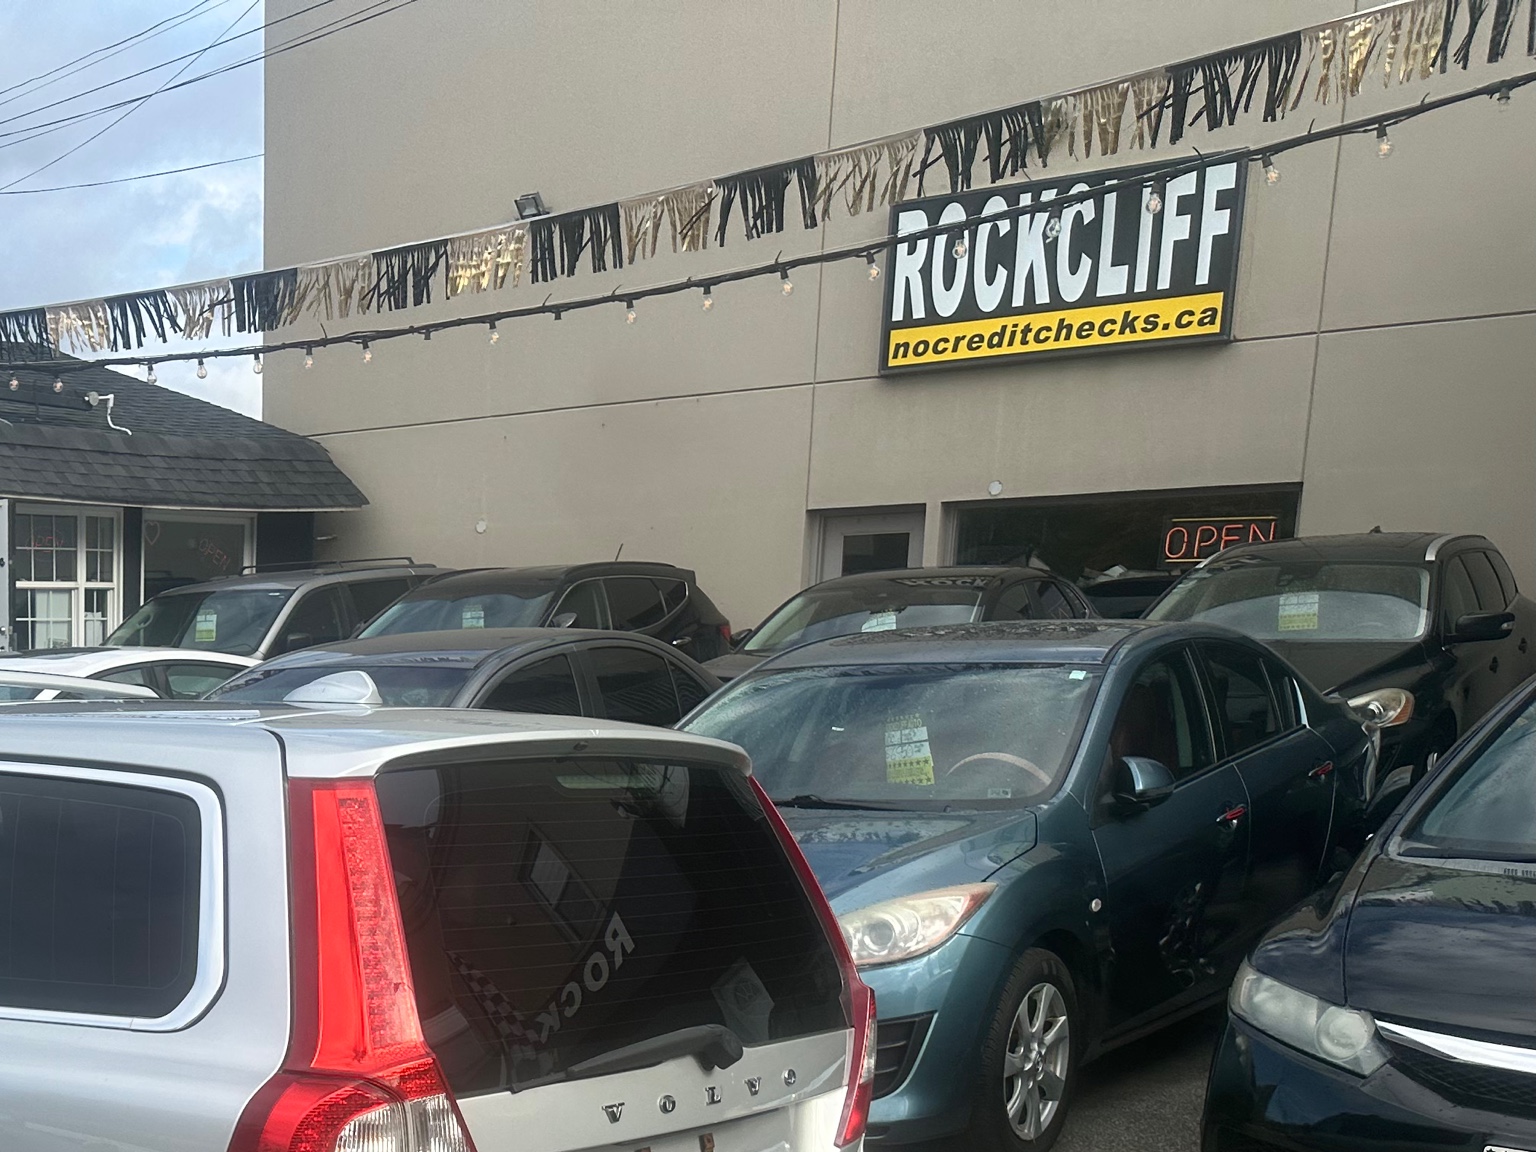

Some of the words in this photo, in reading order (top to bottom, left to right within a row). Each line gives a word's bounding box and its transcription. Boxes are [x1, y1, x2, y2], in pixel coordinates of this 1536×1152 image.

[891, 162, 1238, 322] ROCKCLIFF
[891, 306, 1219, 360] nocreditchecks.ca
[1165, 521, 1275, 559] OPEN
[601, 1068, 797, 1124] VOLVO
